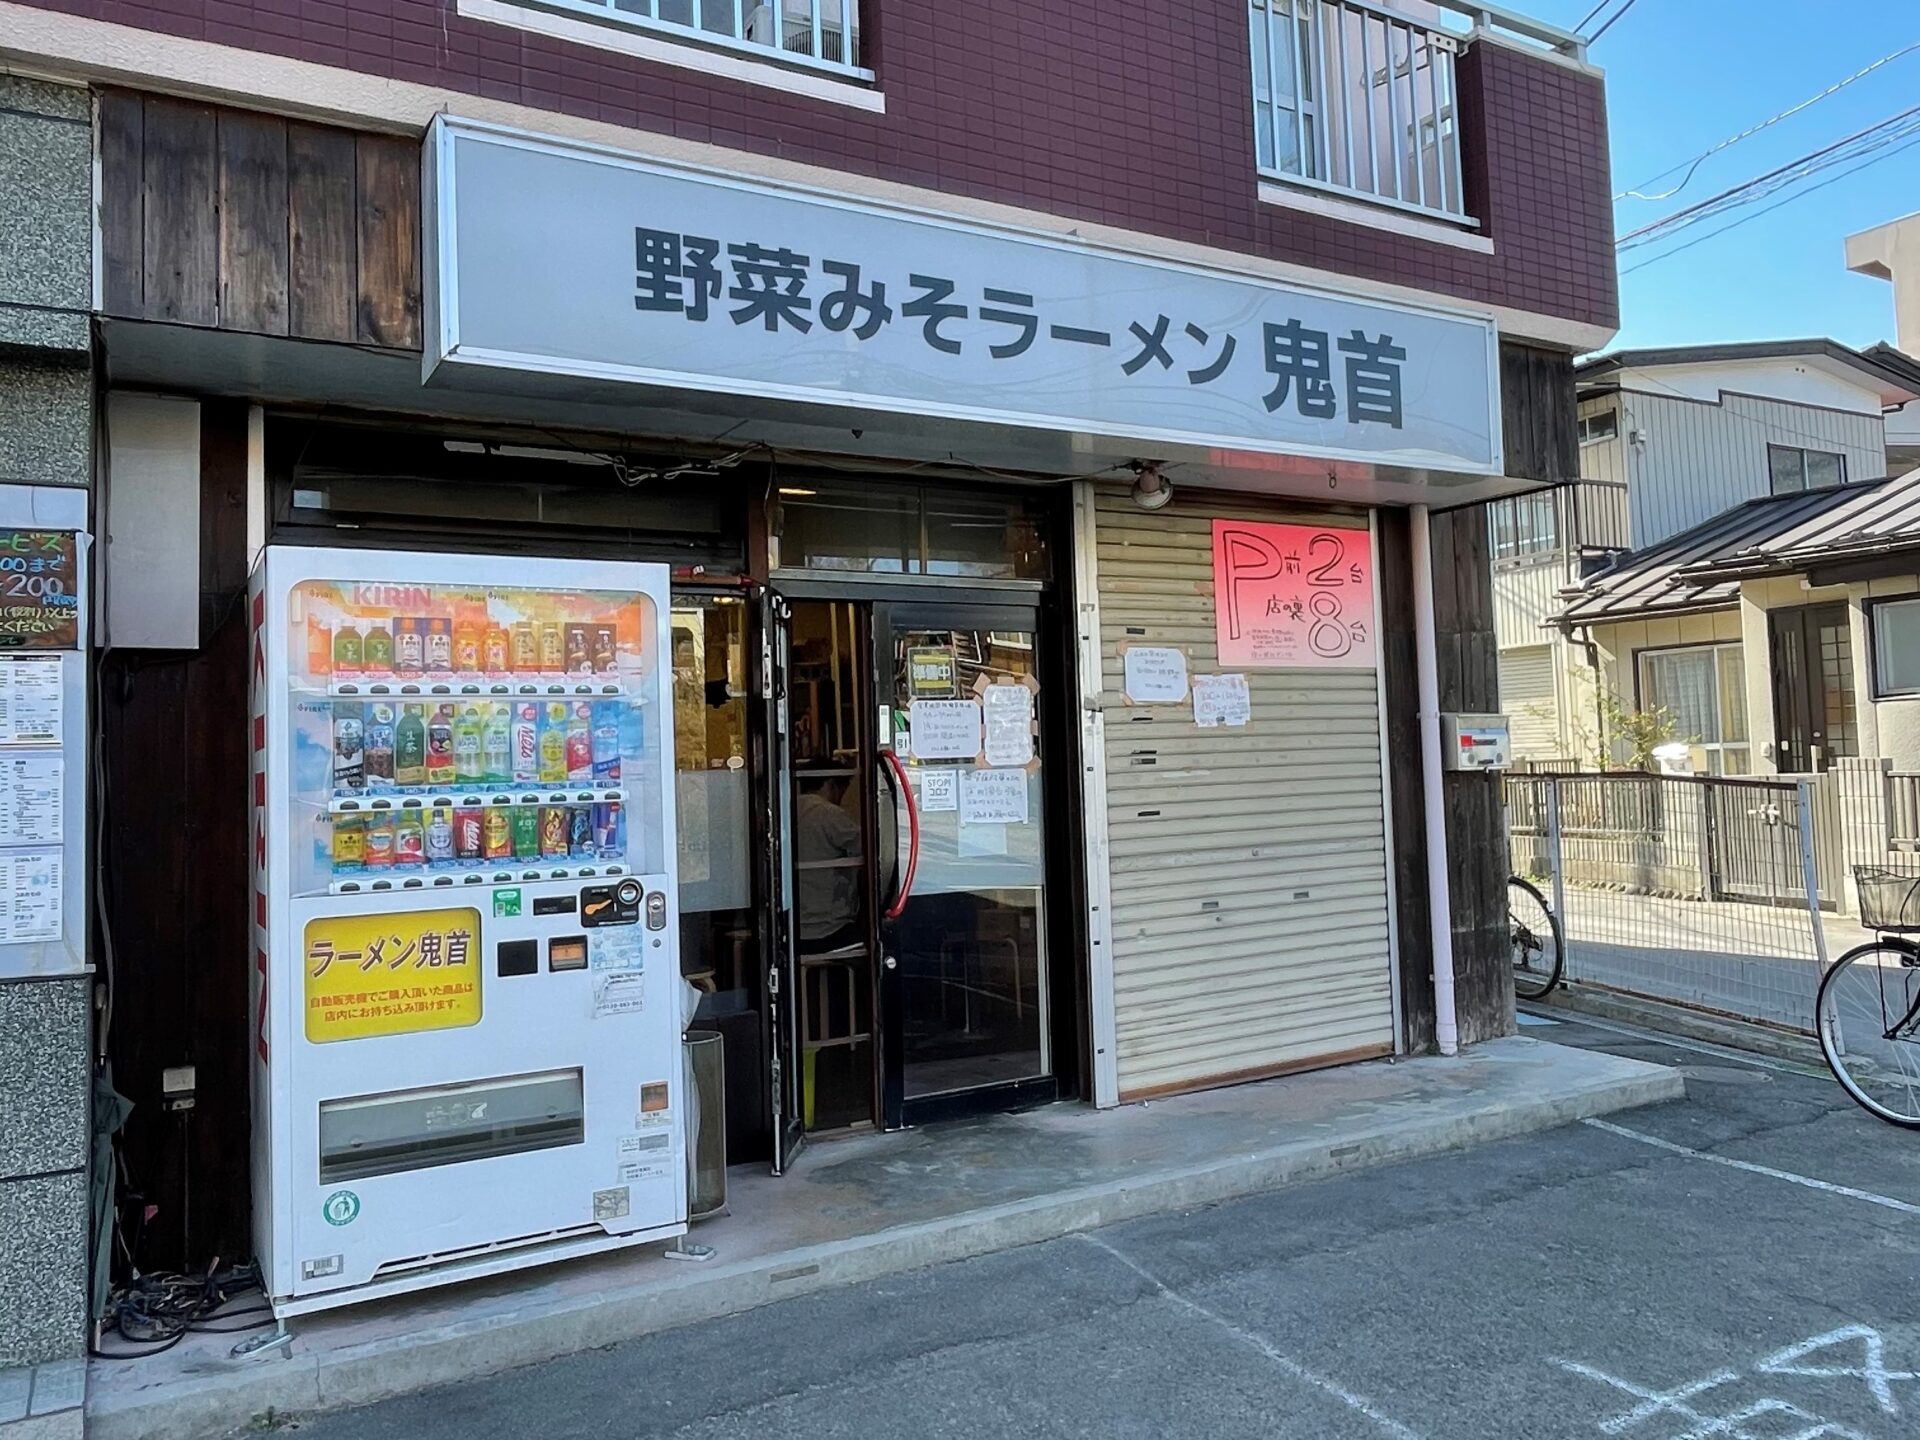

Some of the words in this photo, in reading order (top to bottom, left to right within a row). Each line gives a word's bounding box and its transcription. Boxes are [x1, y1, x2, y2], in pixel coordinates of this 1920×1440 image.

[634, 226, 1238, 386] 野菜みそラーメン
[1261, 318, 1407, 430] 鬼首
[353, 584, 432, 607] KIRIN
[1223, 530, 1283, 640] P
[308, 929, 472, 978] ラーメン鬼首
[311, 983, 473, 1008] 自動販売機でご購入頂いた商品は
